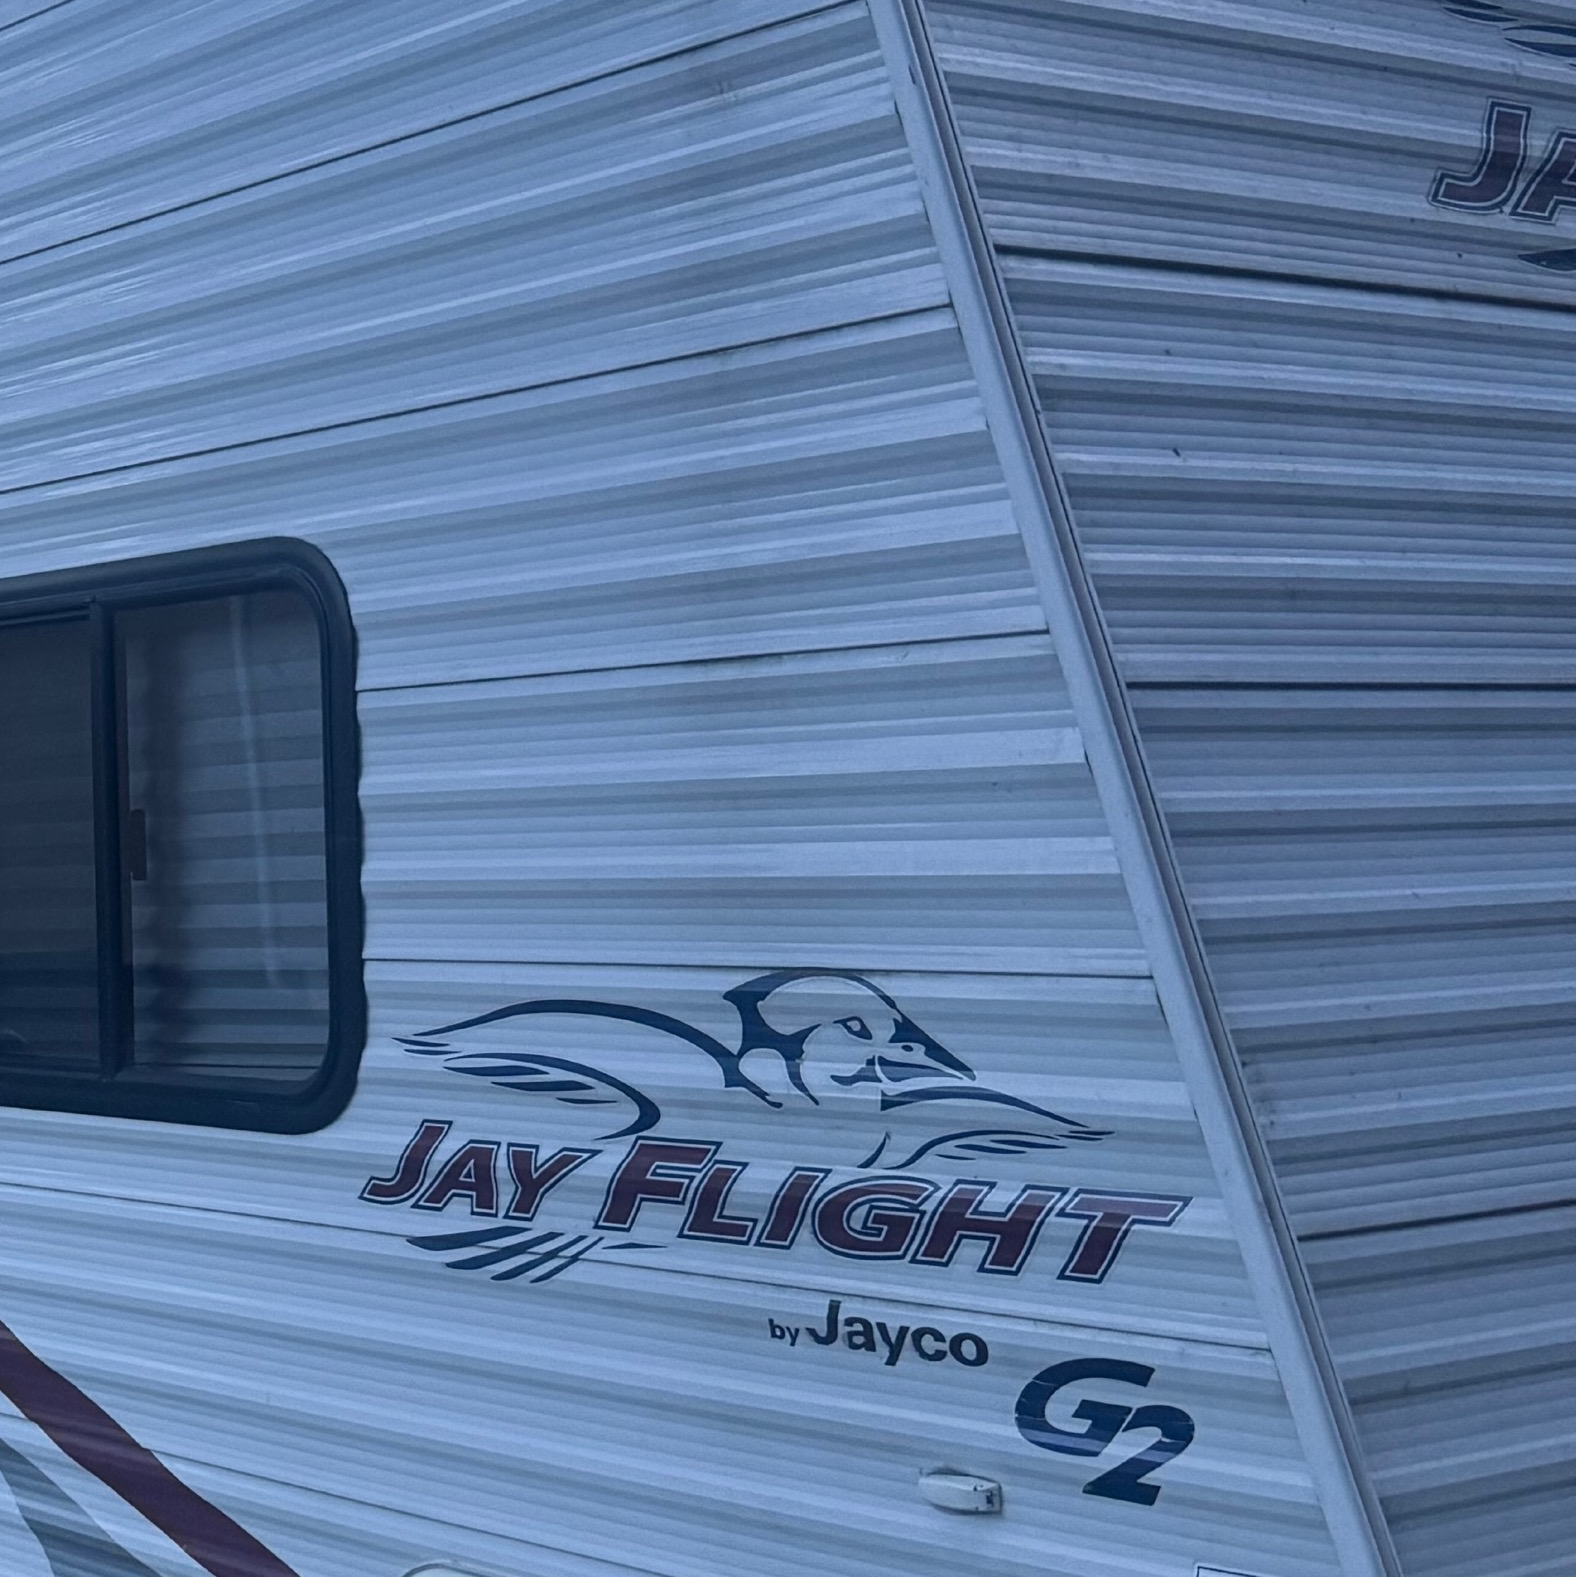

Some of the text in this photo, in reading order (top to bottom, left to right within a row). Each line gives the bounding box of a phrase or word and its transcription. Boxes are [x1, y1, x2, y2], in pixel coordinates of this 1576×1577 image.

[358, 1119, 1194, 1284] JAY FLIGHT
[768, 1299, 990, 1369] by Jayco
[1014, 1356, 1196, 1506] G2
